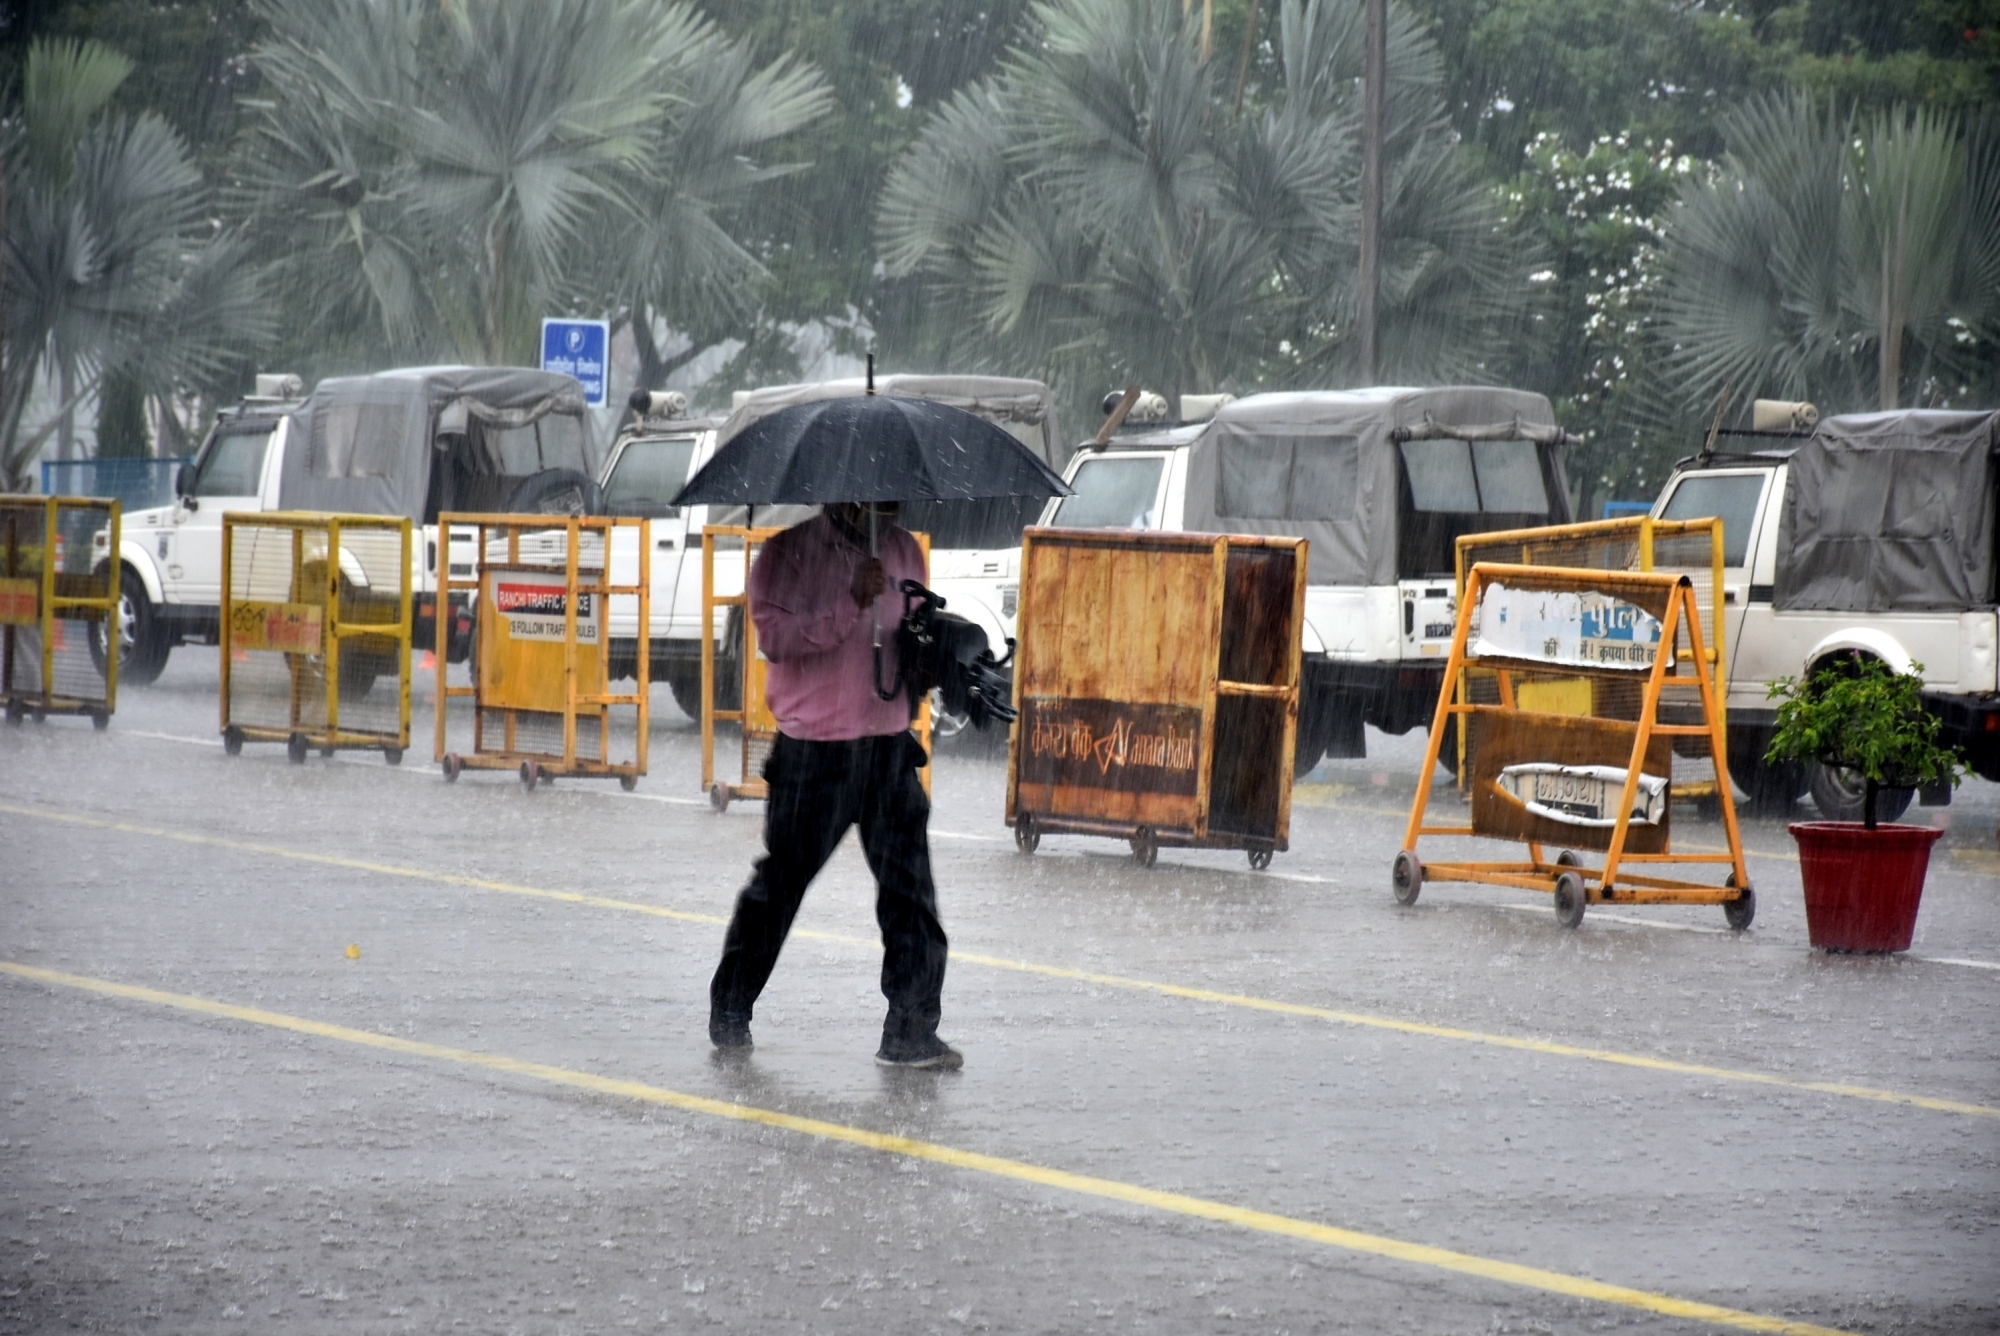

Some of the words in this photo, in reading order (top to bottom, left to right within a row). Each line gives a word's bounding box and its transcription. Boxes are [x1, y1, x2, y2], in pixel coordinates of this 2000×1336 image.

[570, 331, 580, 349] P
[499, 590, 527, 607] RANCHI
[528, 592, 560, 609] TRAFFIC
[561, 594, 590, 611] PCE
[517, 621, 545, 635] FOLLOW
[546, 623, 567, 637] TRAFF
[1590, 603, 1643, 638] पुलि
[1599, 645, 1626, 663] कृपया
[1628, 643, 1645, 662] धीरे
[1167, 724, 1195, 770] Bank
